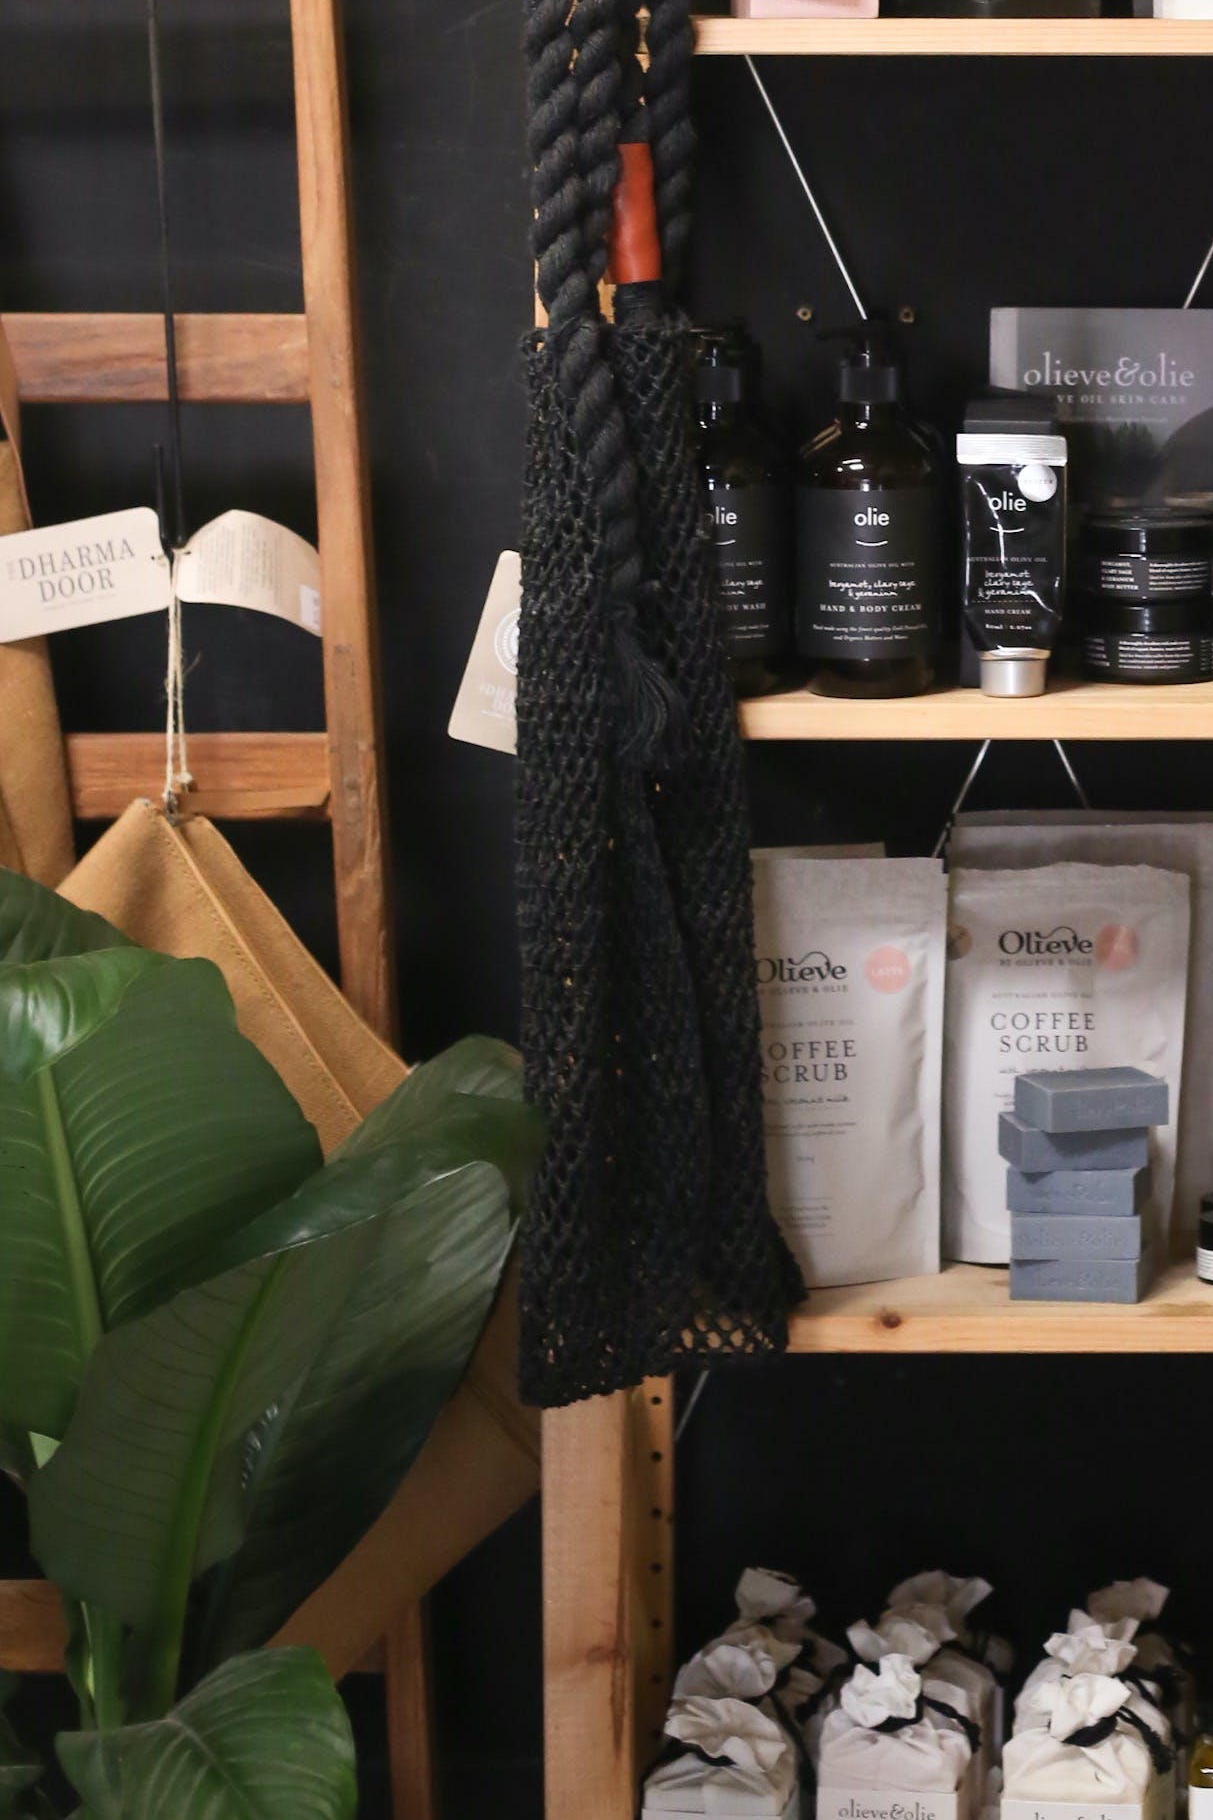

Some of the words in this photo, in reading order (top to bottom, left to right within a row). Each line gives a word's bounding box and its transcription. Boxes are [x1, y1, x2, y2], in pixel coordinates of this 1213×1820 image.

[1023, 351, 1195, 387] olieve&olie
[1080, 395, 1103, 404] OIL
[1110, 395, 1144, 404] SKIN
[1150, 395, 1187, 404] CARE
[989, 491, 1027, 512] olie
[854, 507, 890, 526] olie
[19, 537, 136, 580] DHARMA
[38, 568, 115, 602] DOOR
[820, 603, 846, 612] HAND
[999, 926, 1094, 955] Olieve
[756, 951, 846, 983] Olieve
[990, 1013, 1096, 1030] COFFEE
[768, 1040, 857, 1060] OFFEE
[999, 1035, 1088, 1052] SCRUB
[838, 1798, 936, 1820] olieve&olie
